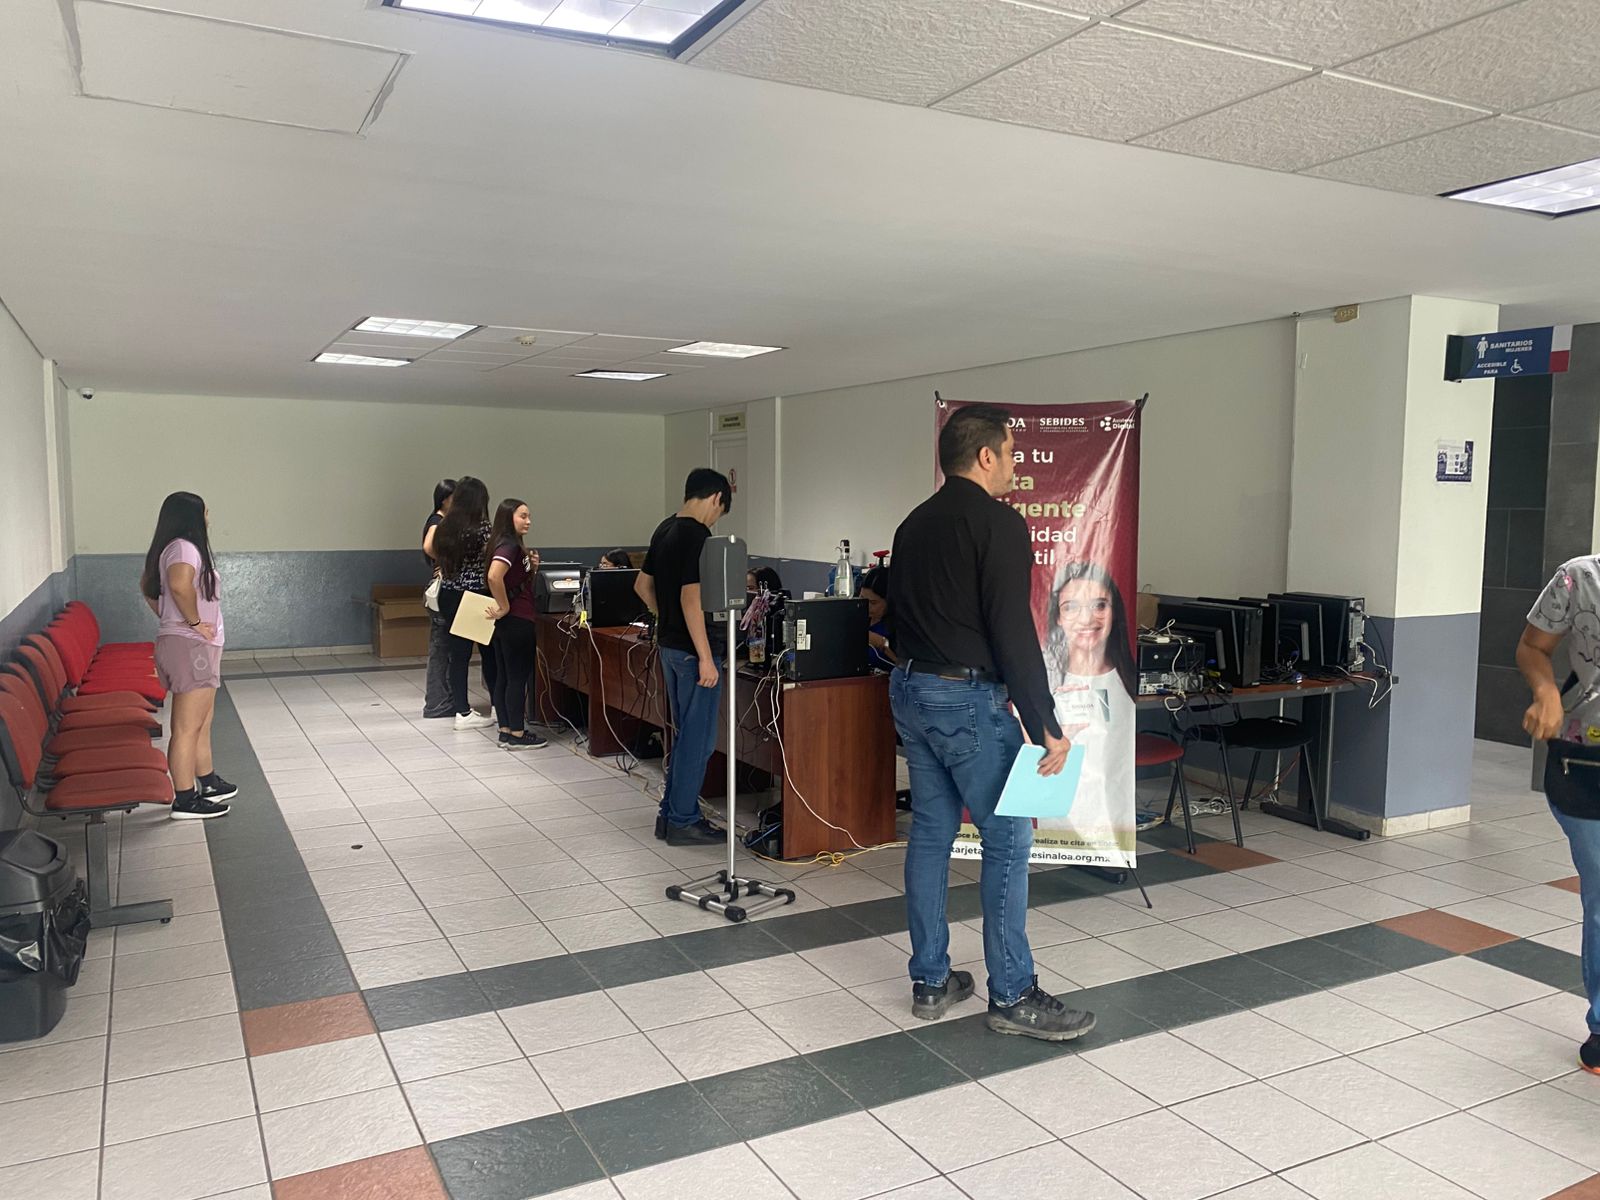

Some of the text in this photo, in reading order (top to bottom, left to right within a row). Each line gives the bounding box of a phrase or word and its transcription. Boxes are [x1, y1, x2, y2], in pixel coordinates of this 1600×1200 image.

[1490, 340, 1533, 349] SANITARIOS
[1006, 417, 1026, 428] OA
[1039, 417, 1085, 426] SEBIDES
[1012, 448, 1054, 463] a tu
[1010, 473, 1034, 490] ta
[1030, 526, 1077, 542] idad
[1033, 549, 1055, 565] til
[952, 846, 1110, 863] tarjeta esinaloa.org.mx
